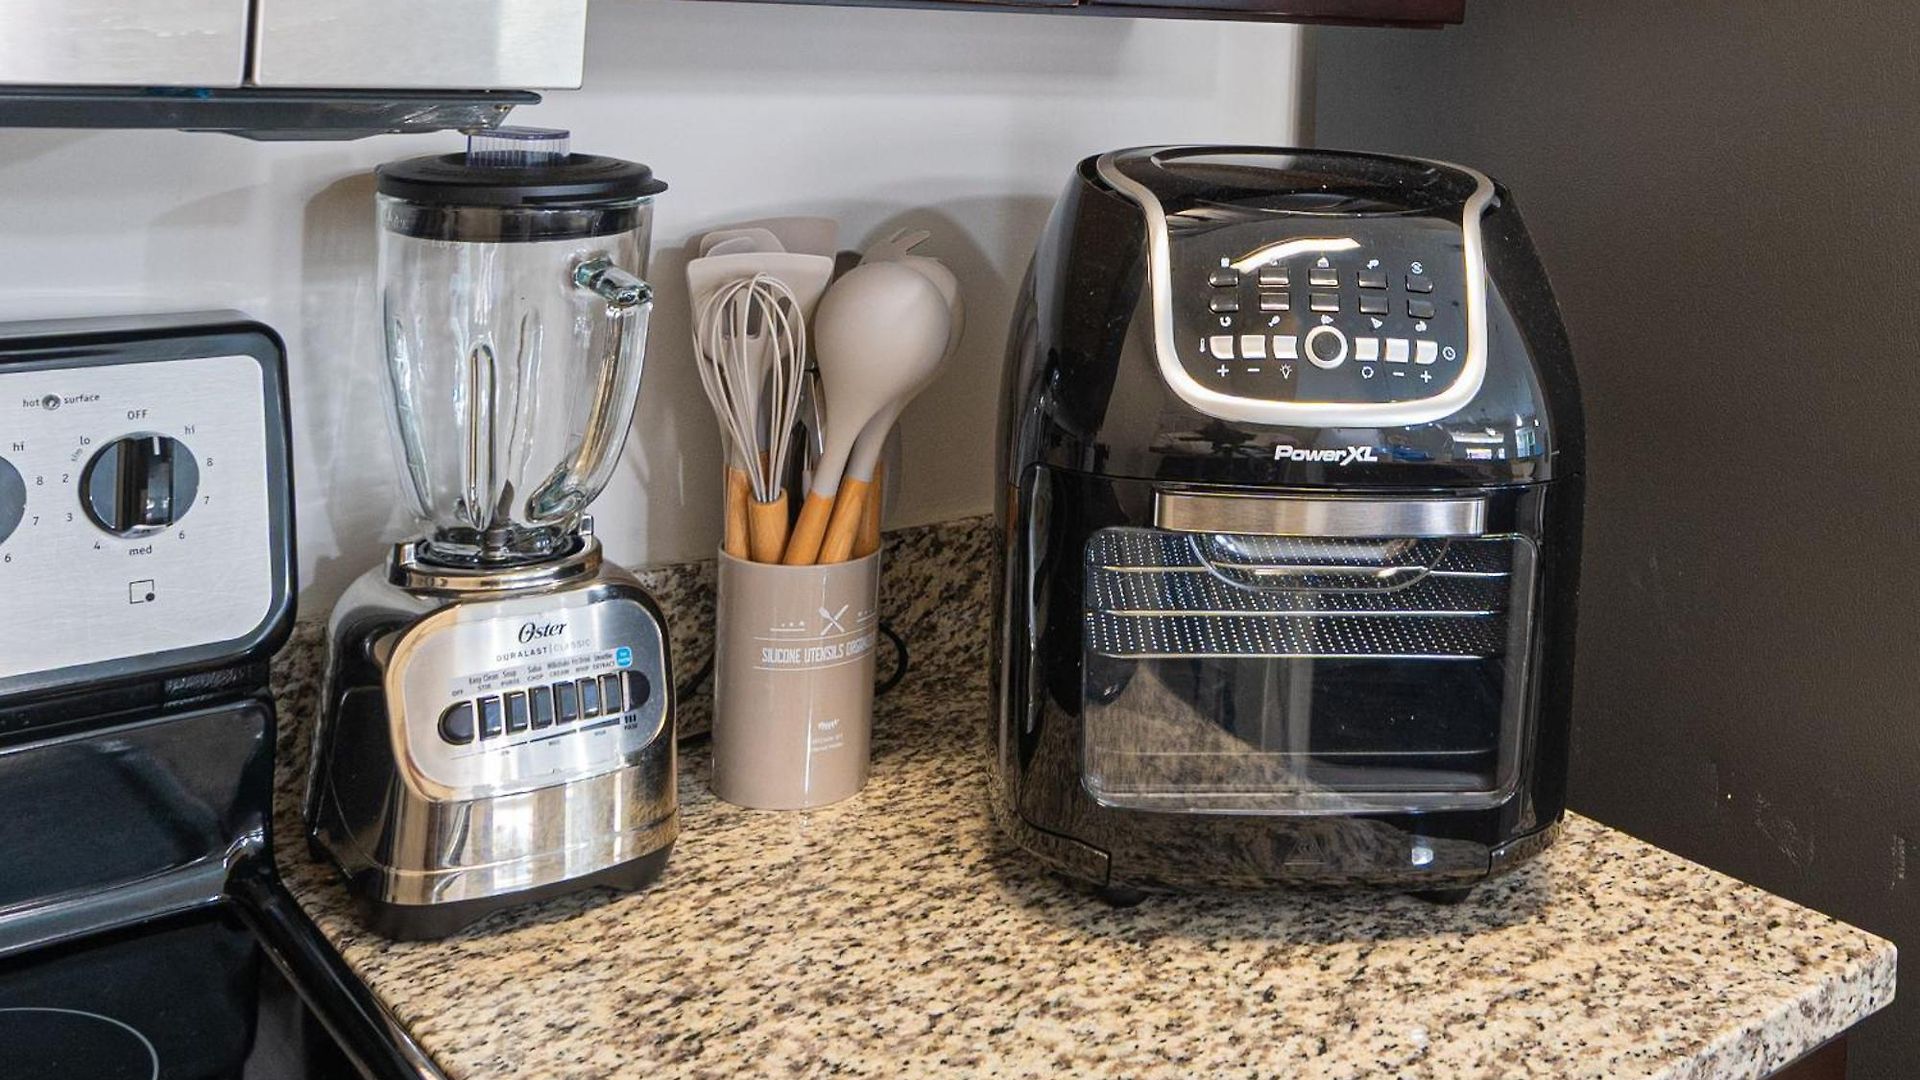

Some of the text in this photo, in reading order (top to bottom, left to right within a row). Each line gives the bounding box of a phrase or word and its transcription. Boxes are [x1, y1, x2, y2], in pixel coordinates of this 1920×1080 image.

[22, 393, 100, 408] hot surface
[127, 409, 148, 420] OFF
[184, 424, 195, 435] hi
[13, 441, 24, 452] hi
[80, 436, 91, 446] lo
[1274, 444, 1378, 466] PowerXL
[206, 457, 214, 467] 8
[36, 475, 43, 486] 8
[62, 473, 69, 484] 2
[204, 496, 210, 505] 7
[33, 516, 39, 526] 7
[66, 513, 73, 522] 3
[179, 530, 185, 540] 6
[94, 541, 101, 550] 4
[129, 544, 152, 556] med
[4, 553, 12, 563] 6
[518, 622, 567, 644] Oster
[496, 646, 547, 662] DURALAST
[762, 647, 801, 664] SILICONE
[804, 643, 844, 664] UTENSILS
